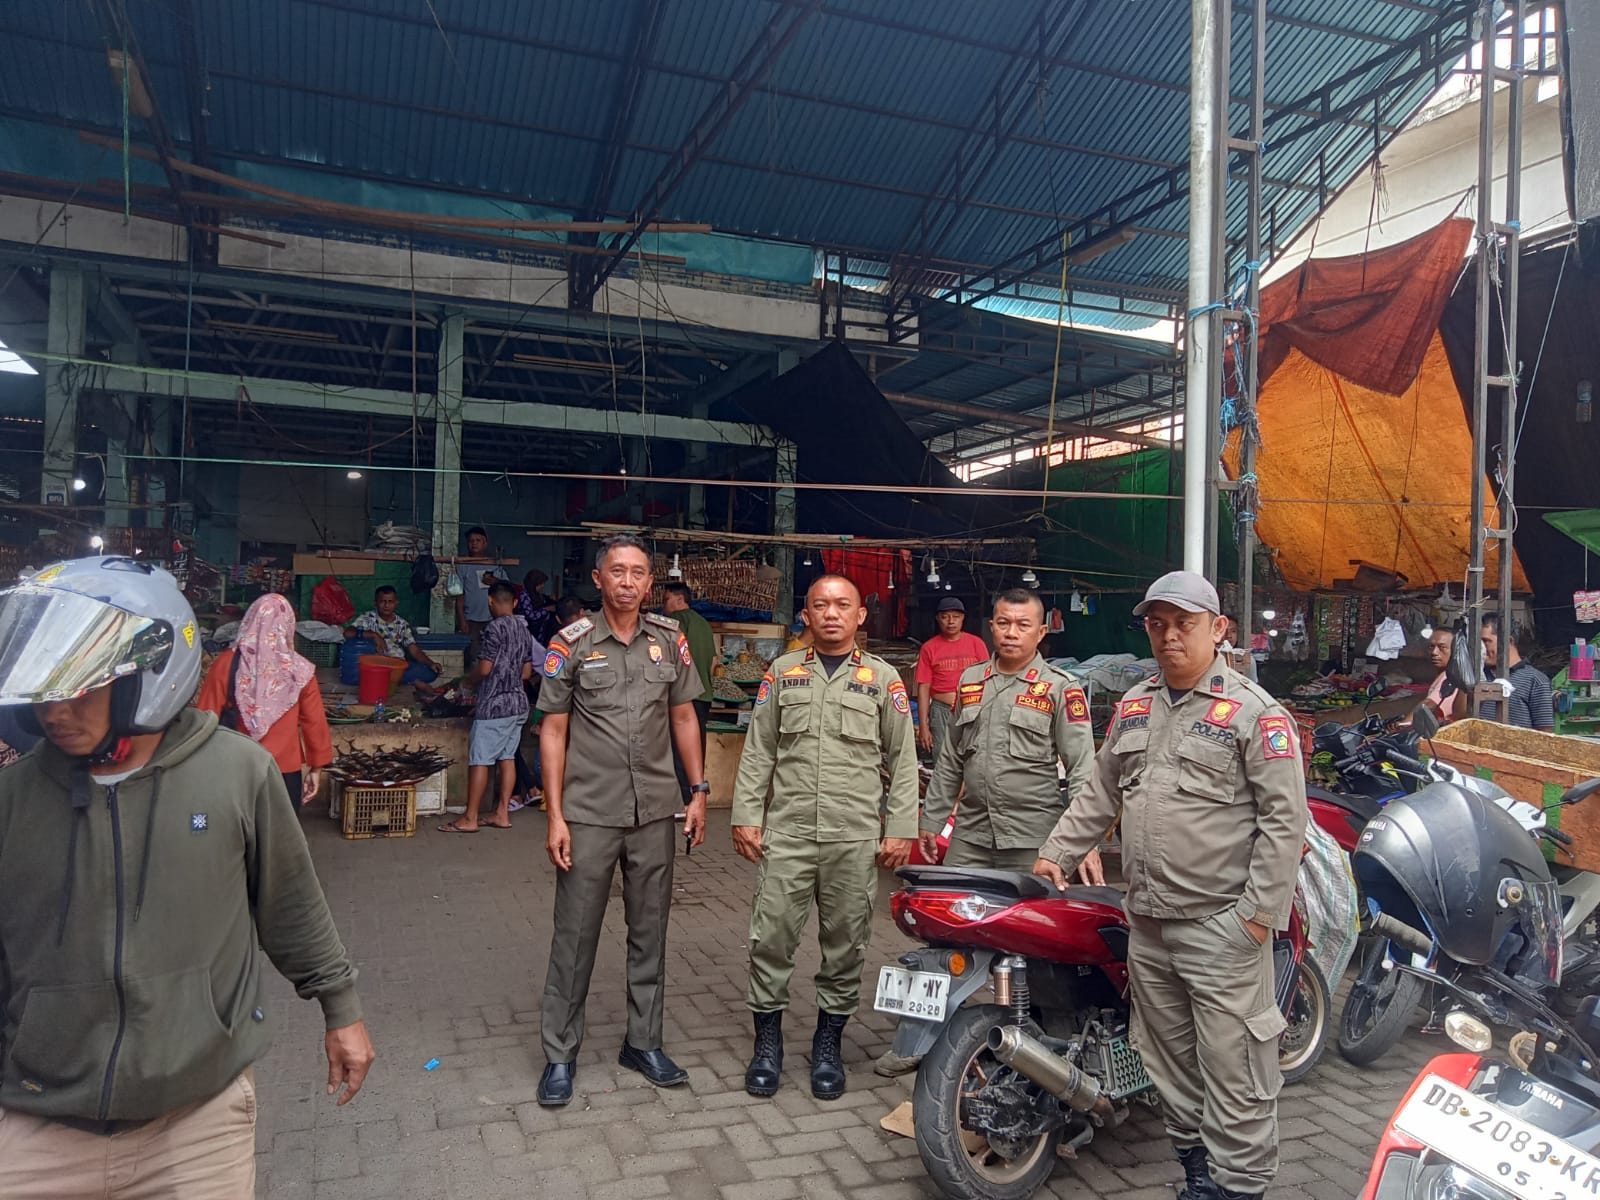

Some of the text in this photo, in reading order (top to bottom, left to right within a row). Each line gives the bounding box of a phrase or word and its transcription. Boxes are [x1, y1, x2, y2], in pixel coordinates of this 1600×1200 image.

[782, 678, 810, 688] ANDRI
[1018, 695, 1050, 710] POLISI
[1191, 721, 1233, 744] POL-PP
[885, 973, 892, 990] T
[926, 979, 942, 999] NY
[1518, 1081, 1564, 1110] YAMAHA
[1422, 1084, 1463, 1115] DB
[1469, 1111, 1553, 1163] 2083
